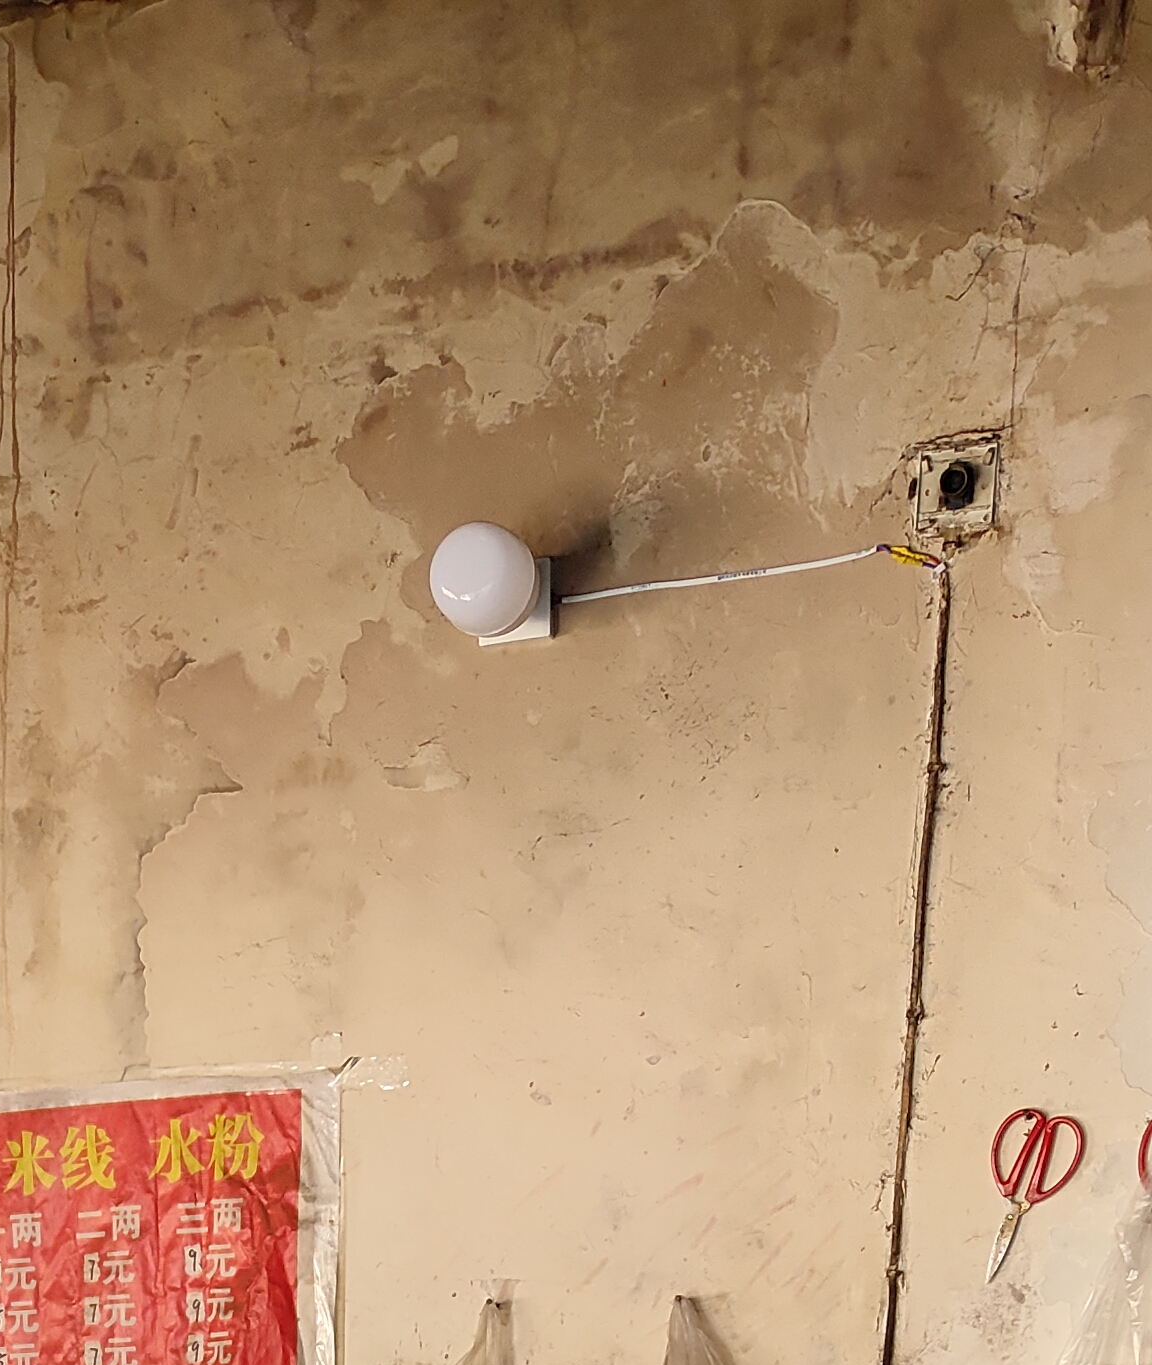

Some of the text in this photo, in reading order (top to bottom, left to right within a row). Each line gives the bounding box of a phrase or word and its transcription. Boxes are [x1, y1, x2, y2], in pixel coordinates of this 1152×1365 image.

[1, 1123, 118, 1195] 米线
[147, 1112, 265, 1183] 水粉
[76, 1204, 141, 1241] 二两
[176, 1197, 244, 1234] 三两
